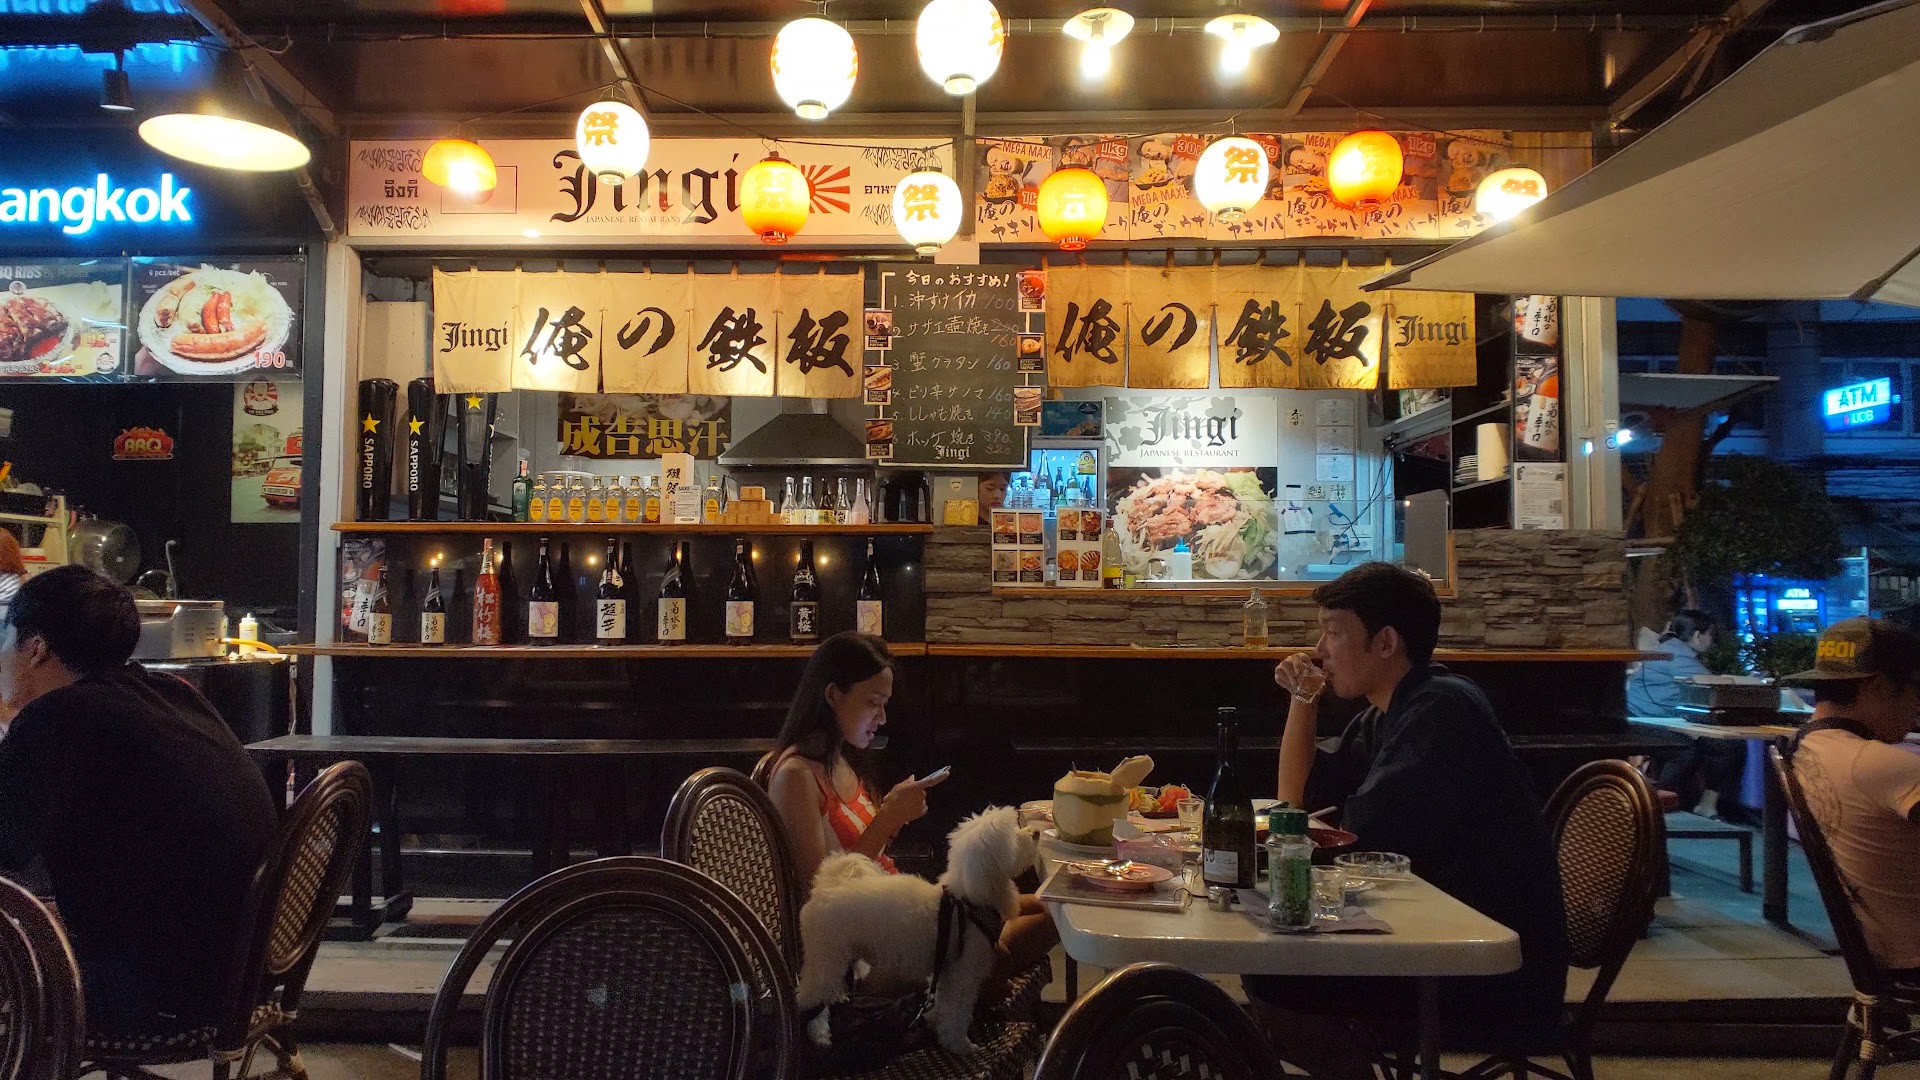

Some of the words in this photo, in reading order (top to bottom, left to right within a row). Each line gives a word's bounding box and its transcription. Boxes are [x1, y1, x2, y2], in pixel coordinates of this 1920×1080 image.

[584, 111, 619, 147] 祭
[1002, 141, 1026, 156] MEGA
[1408, 137, 1436, 155] 1kg
[1224, 145, 1261, 184] 祭
[902, 183, 941, 222] 祭
[1131, 192, 1159, 207] MEGA
[1160, 186, 1187, 201] MAX!
[1287, 194, 1328, 218] 俺の
[978, 199, 1016, 223] 俺の
[1131, 202, 1170, 227] 俺の
[1364, 203, 1403, 226] 俺の
[15, 266, 42, 279] RIBS
[905, 269, 1010, 288] 今日のおすすめ!
[440, 321, 509, 353] Jingi
[1394, 314, 1470, 348] Jingi
[254, 351, 286, 369] 190
[1839, 383, 1878, 408] ATM
[560, 416, 729, 456] 成吉思汗
[1141, 405, 1239, 447] Jingi
[363, 438, 375, 489] SAPPORO
[934, 444, 971, 461] Jingi
[1140, 449, 1181, 458] JAPANESE
[1184, 449, 1240, 457] RESTAURANT
[410, 440, 419, 492] SAPPORO
[476, 587, 496, 641] 松竹梅
